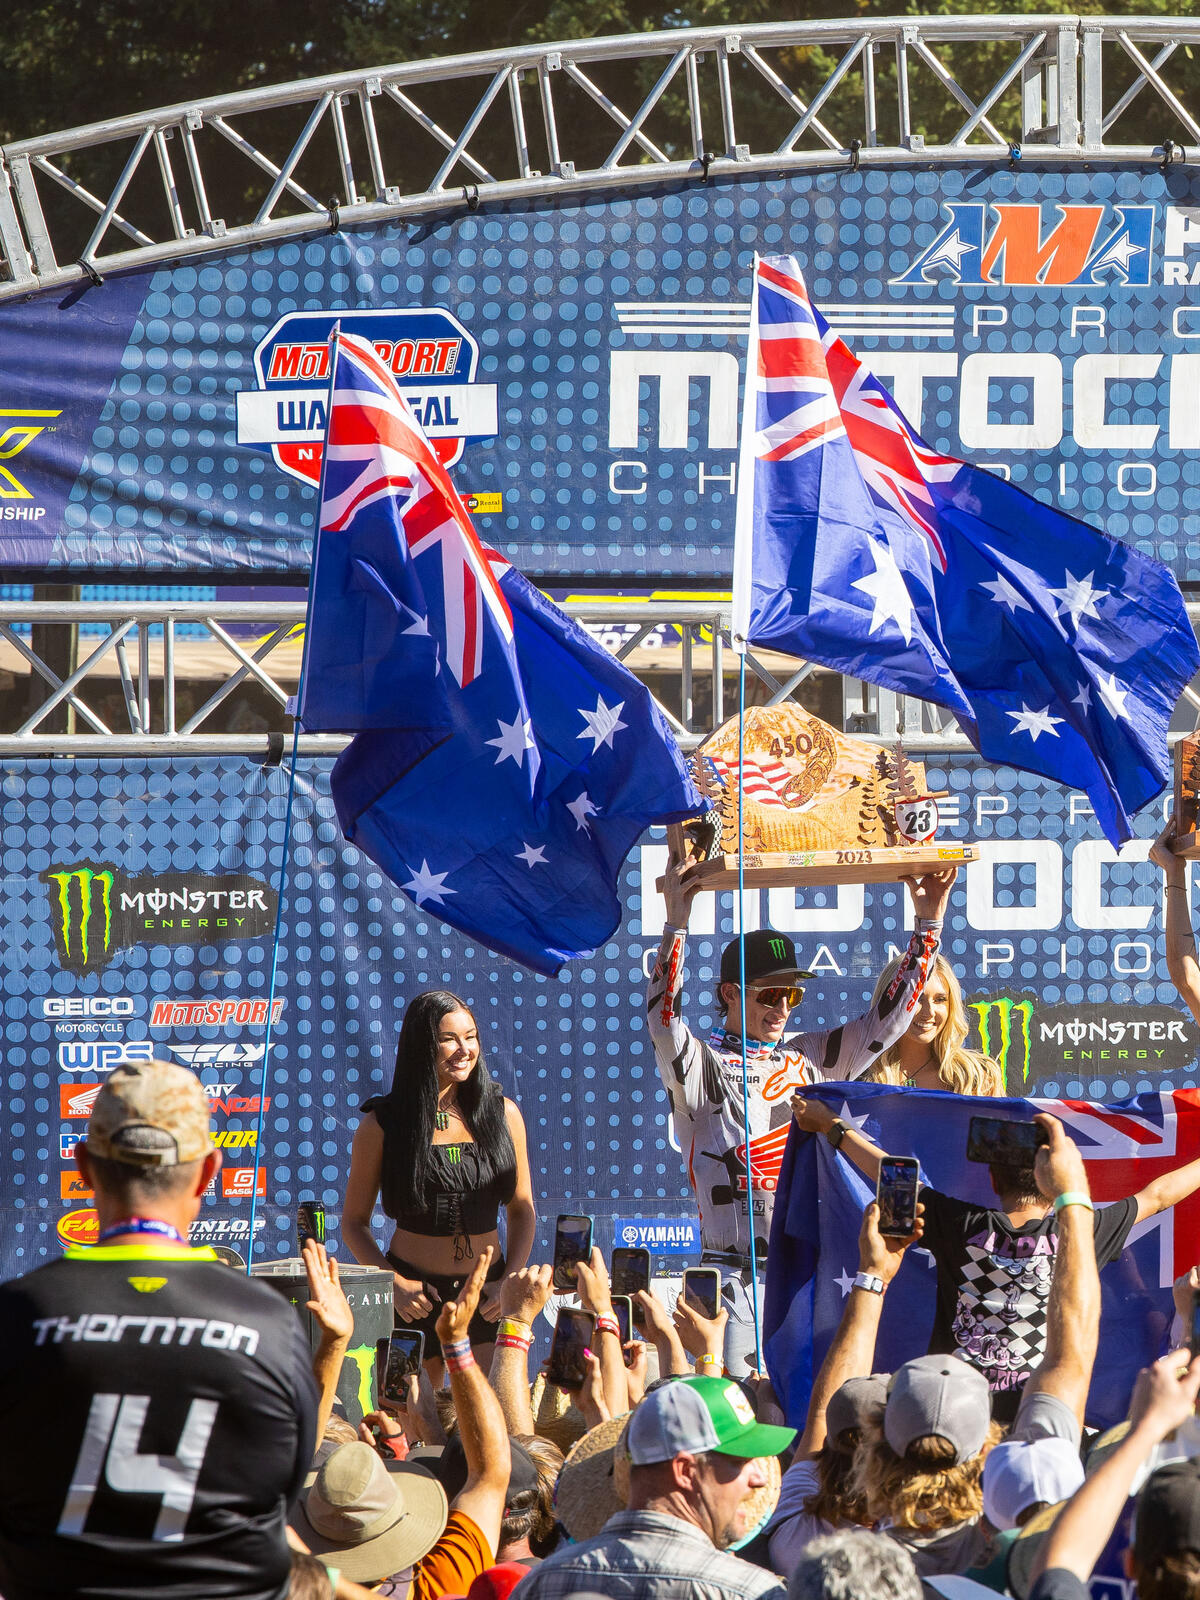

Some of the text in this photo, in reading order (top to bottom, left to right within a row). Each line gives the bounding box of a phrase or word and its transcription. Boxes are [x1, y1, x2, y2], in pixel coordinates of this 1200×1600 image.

[889, 203, 1156, 286] AMA
[769, 733, 813, 759] 450
[905, 810, 931, 833] 23
[836, 850, 873, 865] 2023
[120, 887, 269, 916] MONSTER
[144, 917, 246, 929] ENERGY
[43, 997, 134, 1016] GEICO
[55, 1023, 123, 1033] MOTORCYCLE
[1040, 1017, 1189, 1047] MONSTER
[59, 1041, 276, 1072] WPS FLY
[1064, 1049, 1165, 1060] ENERGY
[203, 1084, 238, 1097] ATV
[209, 1130, 258, 1148] HOR
[63, 1219, 266, 1233] FM UNLOP
[639, 1226, 694, 1241] YAMAHA
[33, 1314, 260, 1356] THORNTON
[57, 1392, 220, 1542] 14
